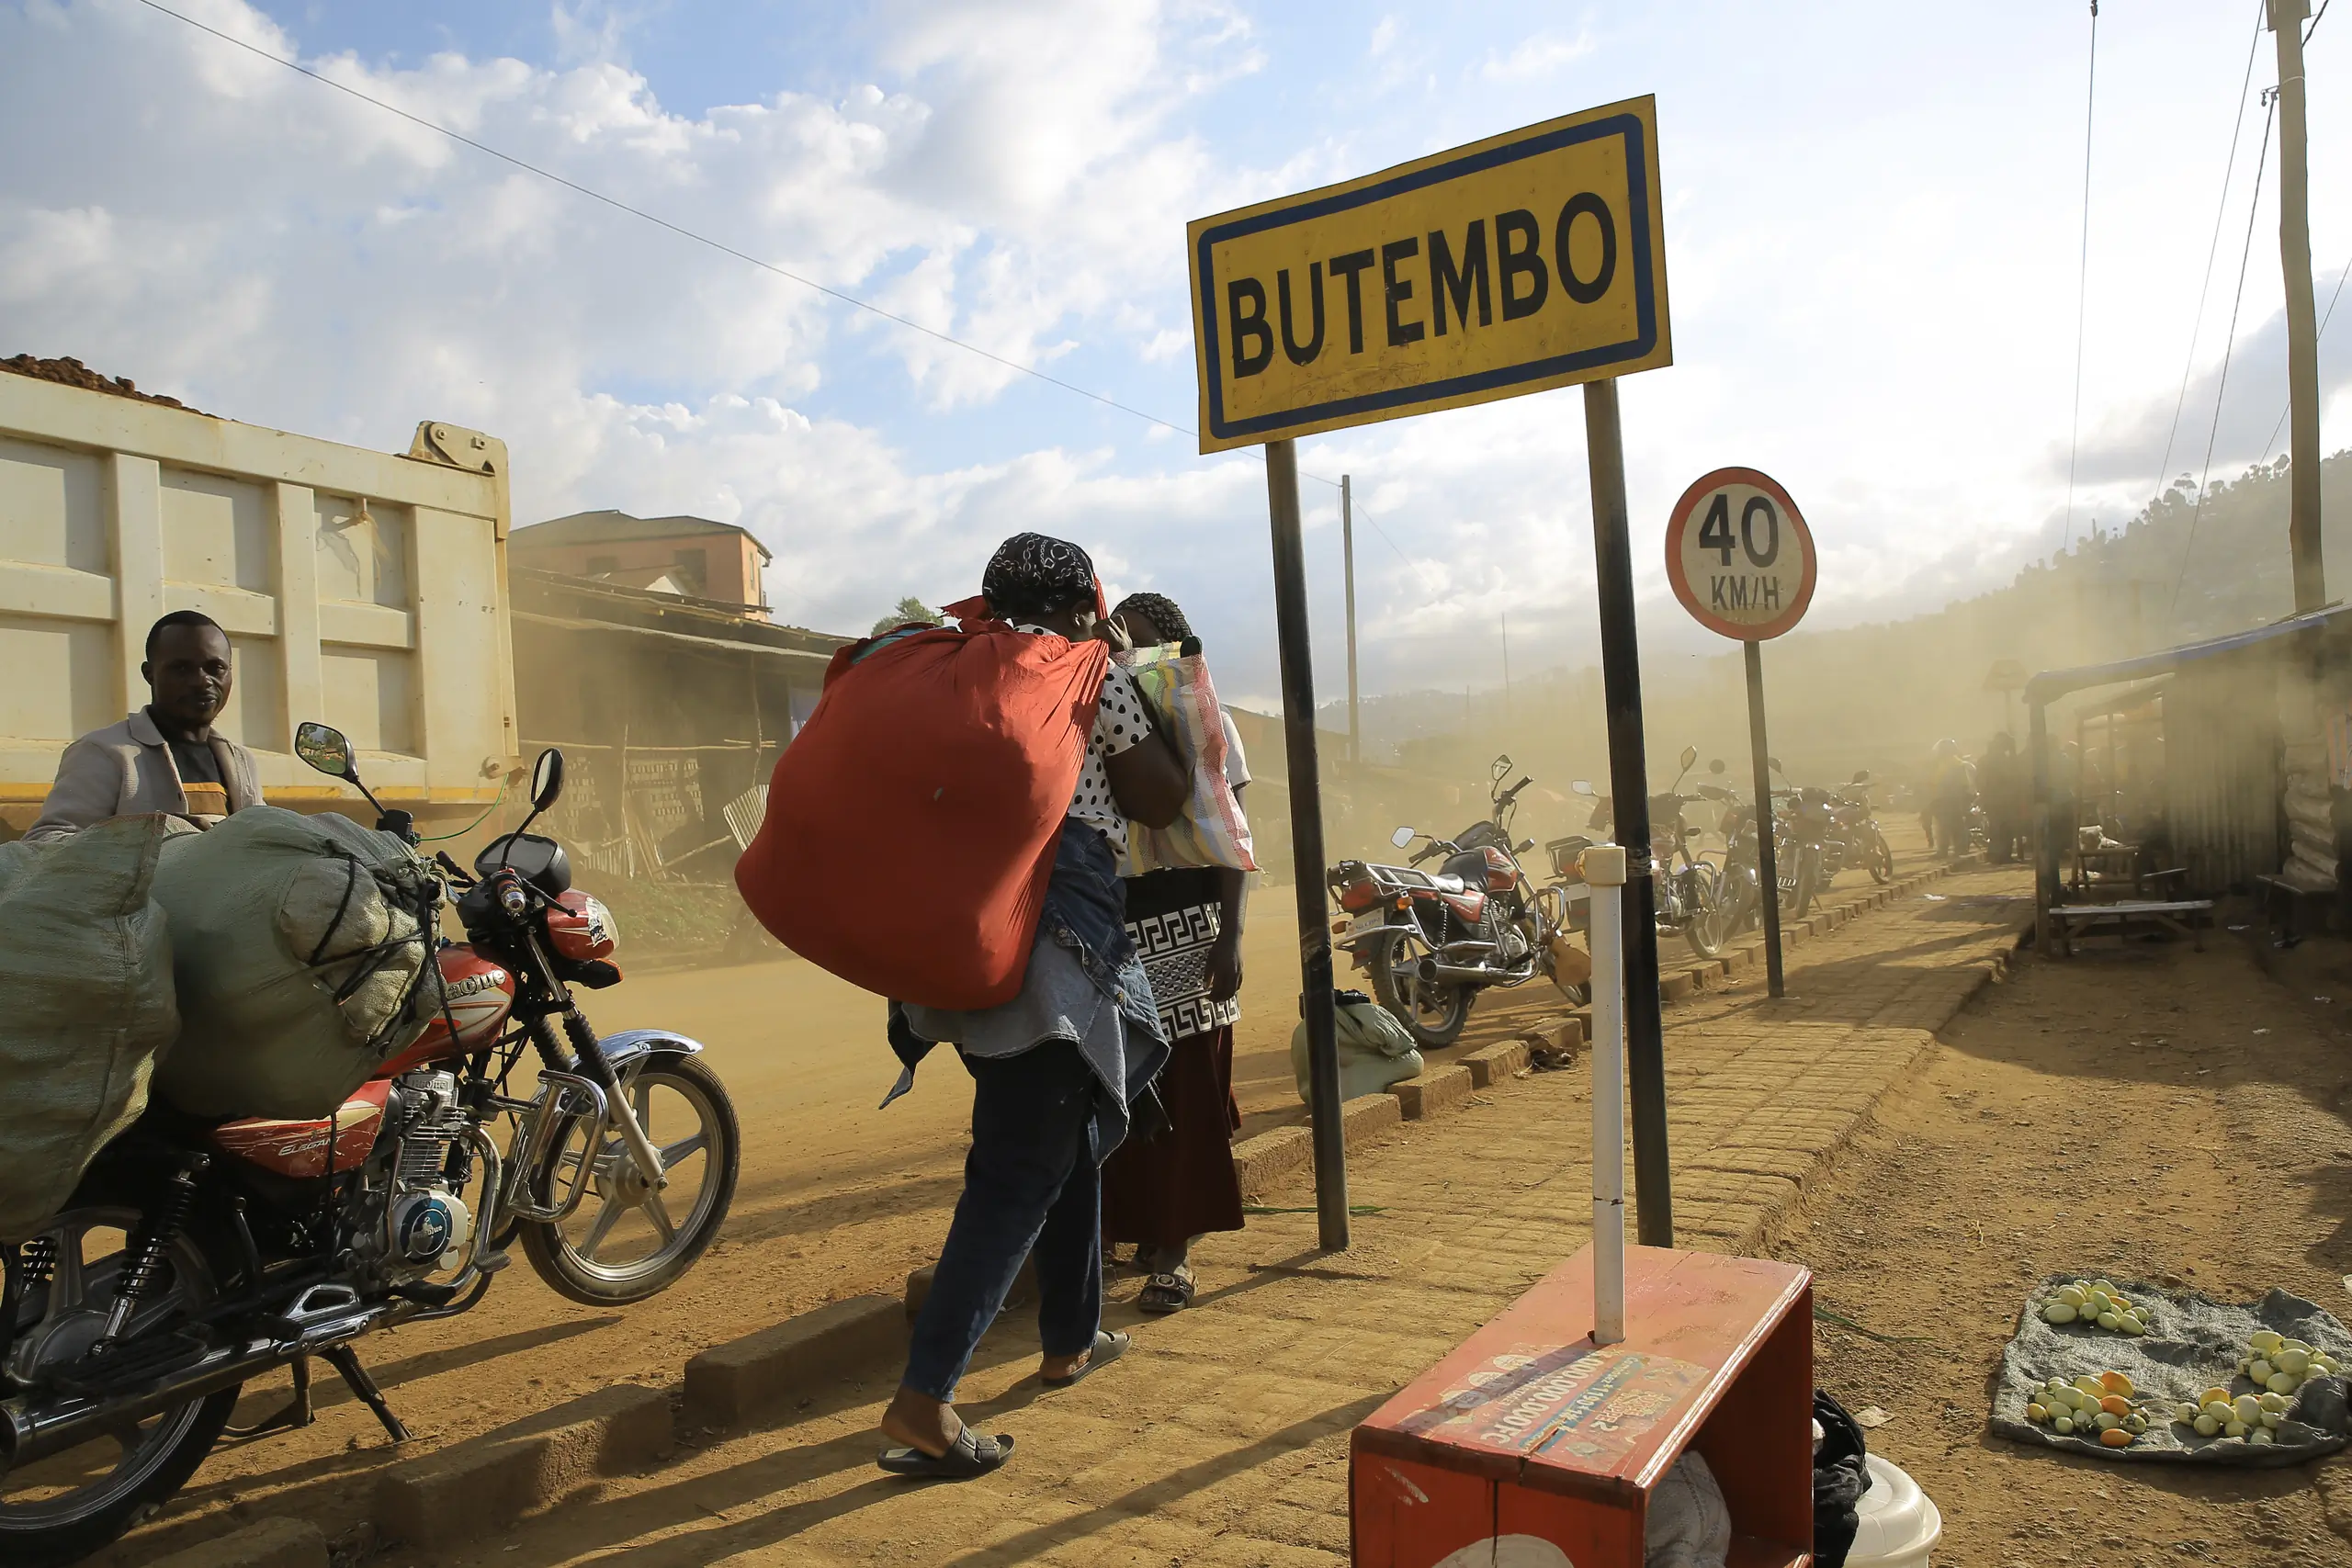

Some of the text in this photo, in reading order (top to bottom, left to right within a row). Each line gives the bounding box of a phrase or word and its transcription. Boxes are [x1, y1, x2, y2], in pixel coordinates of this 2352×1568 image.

[1227, 192, 1617, 378] BUTEMBO
[1699, 494, 1780, 568] 40
[1711, 575, 1780, 611] KM/H
[445, 969, 506, 999] aojue
[278, 1134, 347, 1156] ELEGANT
